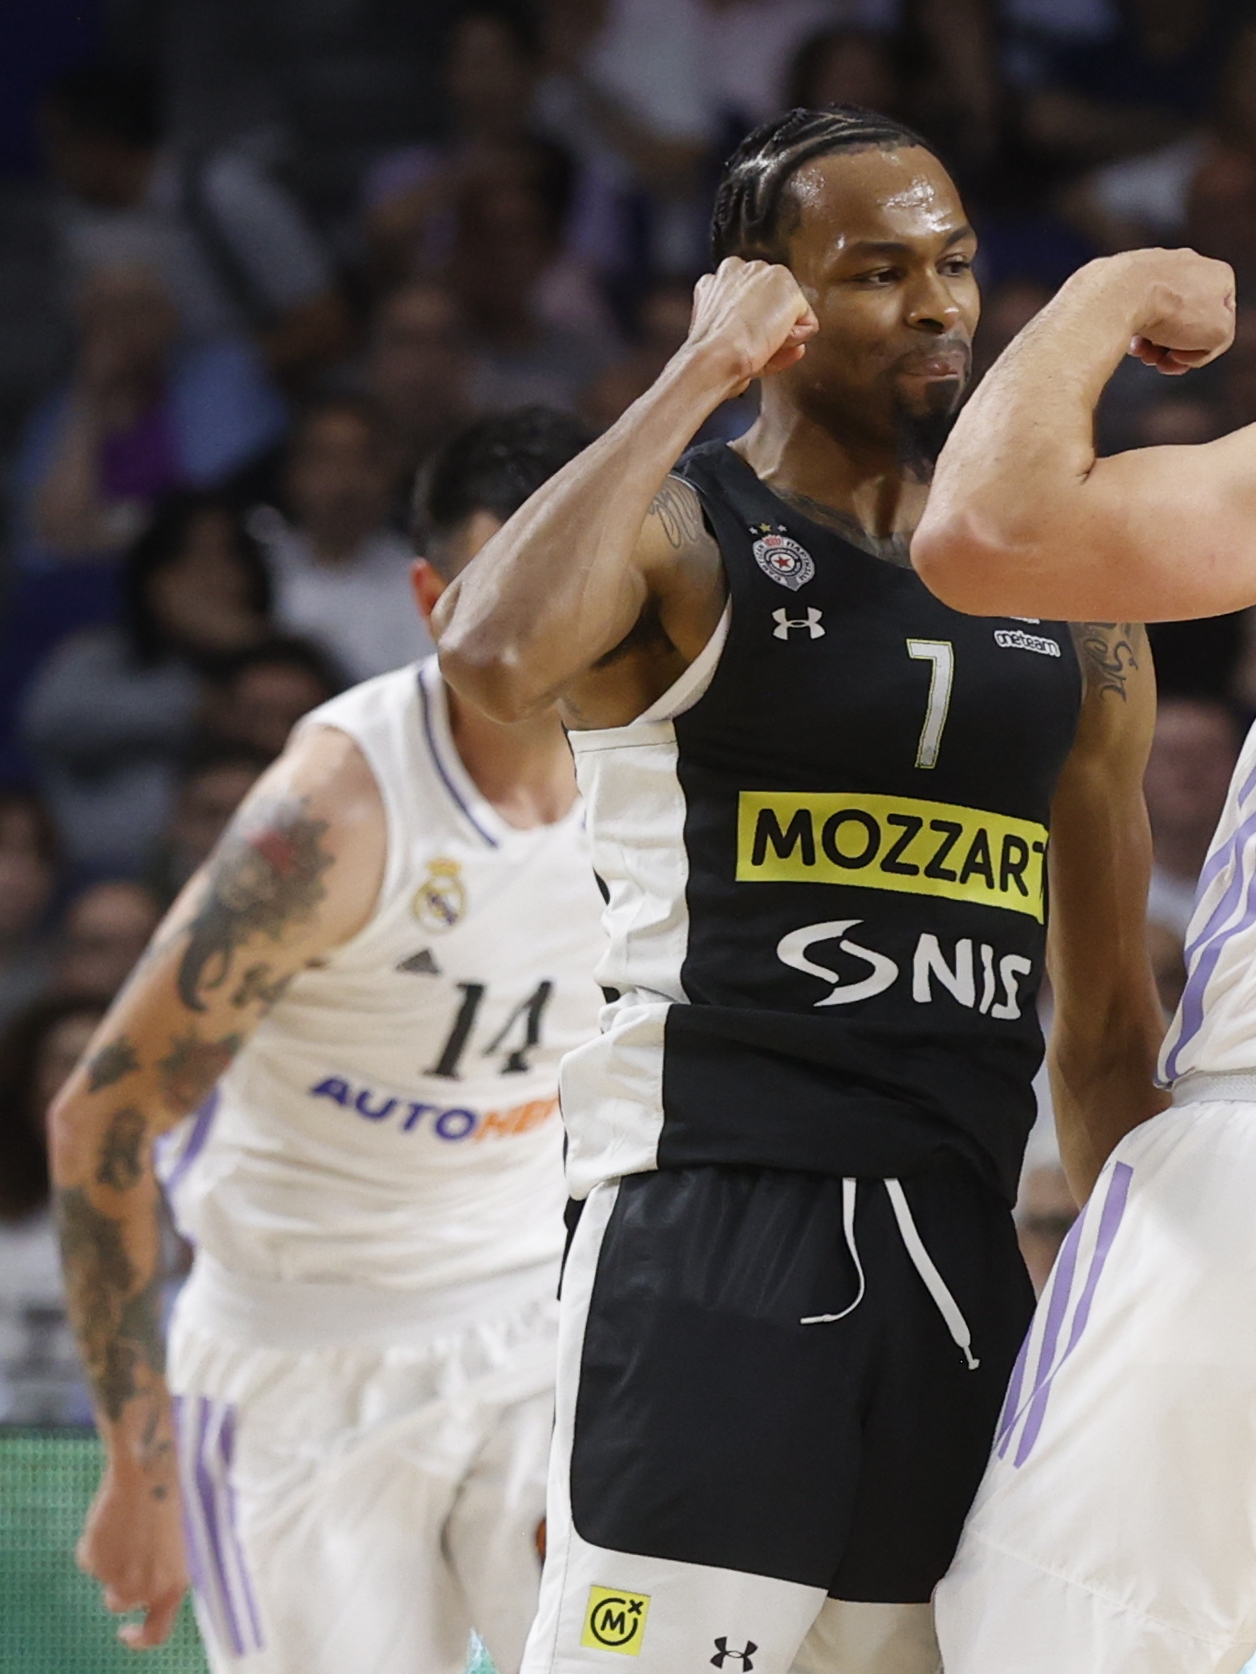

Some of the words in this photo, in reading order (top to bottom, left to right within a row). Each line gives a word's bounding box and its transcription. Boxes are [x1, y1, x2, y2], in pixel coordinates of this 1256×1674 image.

[995, 631, 1060, 657] oneteam
[906, 638, 954, 769] 7
[913, 932, 1032, 1020] NIS
[423, 979, 554, 1081] 14
